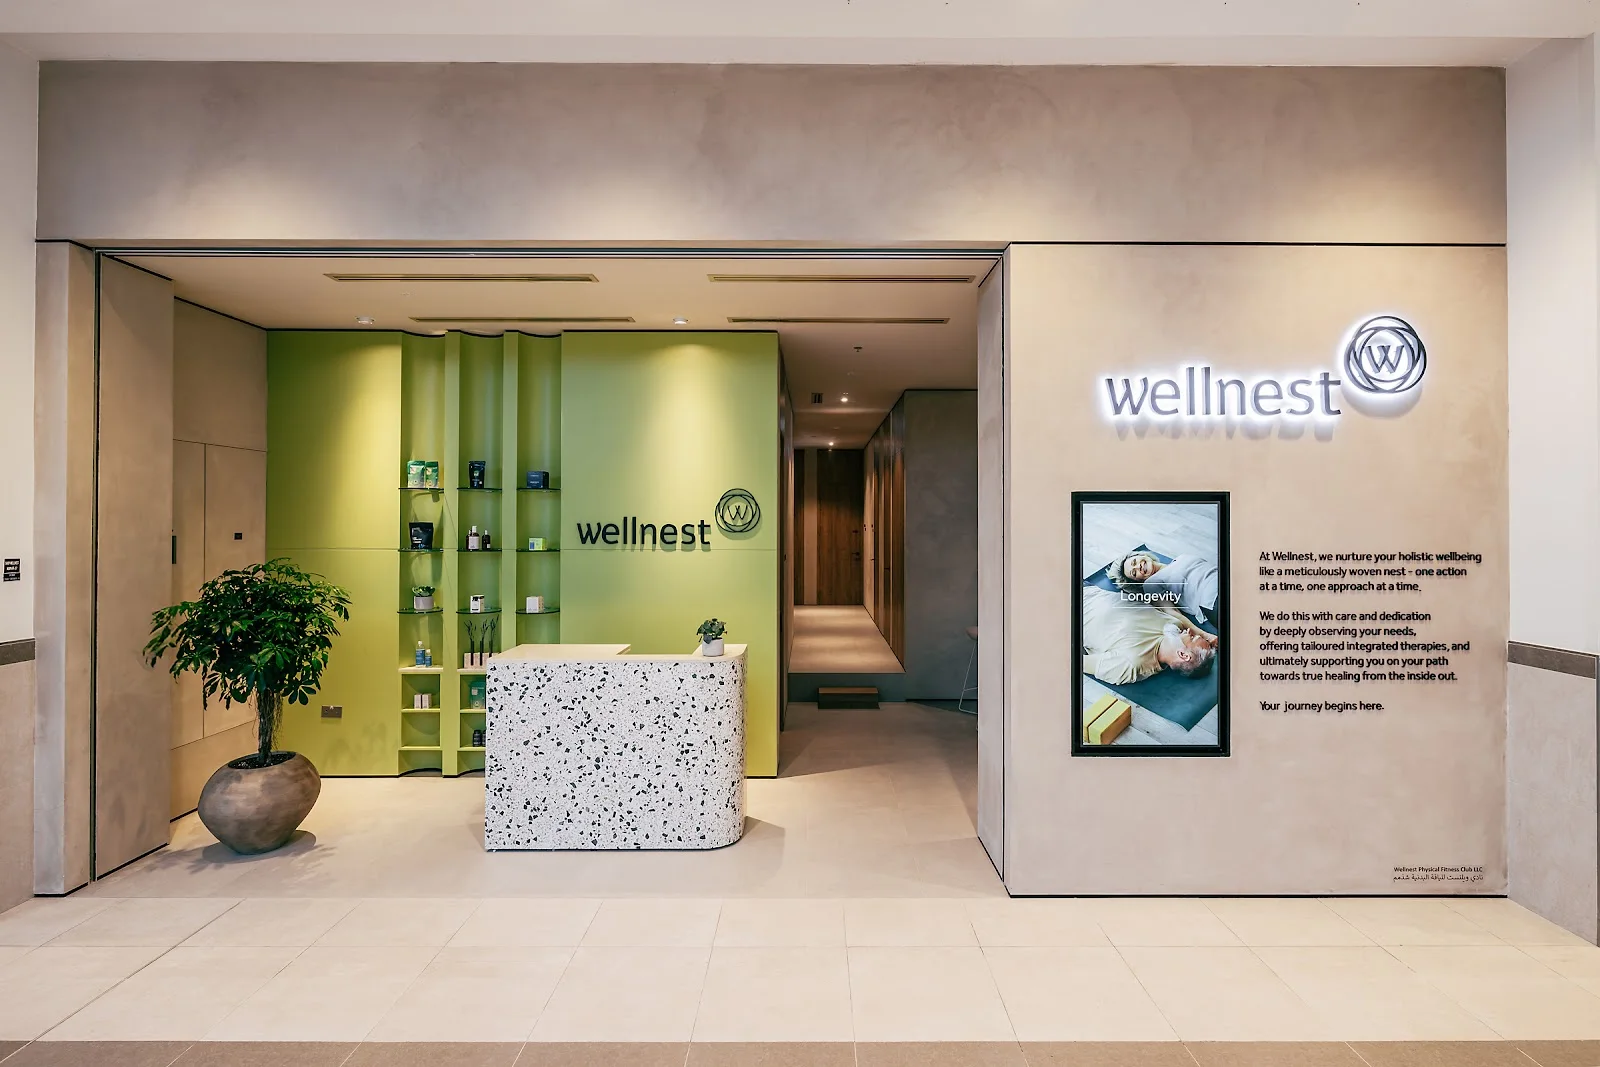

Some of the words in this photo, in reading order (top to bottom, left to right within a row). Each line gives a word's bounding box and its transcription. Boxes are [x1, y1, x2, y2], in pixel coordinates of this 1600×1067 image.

[1104, 366, 1342, 416] wellnest
[577, 516, 711, 545] wellnest
[1259, 552, 1270, 561] At
[1272, 551, 1317, 562] Wellnest,
[1336, 553, 1372, 561] nurture
[1374, 554, 1395, 563] your
[1398, 551, 1434, 561] holistic
[1435, 551, 1482, 563] wellbeing
[1259, 566, 1274, 576] like
[1285, 566, 1347, 578] meticulously
[1384, 567, 1406, 576] nest
[1436, 567, 1467, 576] action
[1259, 582, 1270, 591] at
[1279, 582, 1304, 592] time,
[1328, 581, 1374, 593] approach
[1376, 582, 1386, 591] at
[1396, 582, 1421, 591] time.
[1120, 590, 1181, 604] Longevity
[1260, 612, 1274, 620] We
[1277, 611, 1290, 620] do
[1292, 611, 1310, 620] this
[1312, 611, 1333, 620] with
[1359, 611, 1377, 620] and
[1379, 611, 1431, 620] dedication
[1260, 626, 1271, 638] by
[1274, 626, 1306, 638] deeply
[1309, 626, 1357, 638] observing
[1359, 628, 1381, 638] your
[1383, 626, 1416, 636] needs,
[1260, 641, 1298, 652] offering
[1301, 641, 1344, 650] tailoured
[1347, 641, 1398, 652] integrated
[1400, 641, 1449, 652] therapies,
[1452, 641, 1470, 650] and
[1260, 656, 1308, 667] ultimately
[1310, 656, 1364, 667] supporting
[1366, 658, 1385, 667] you
[1402, 658, 1424, 667] your
[1426, 656, 1448, 667] path
[1260, 671, 1300, 680] towards
[1302, 672, 1323, 680] true
[1325, 671, 1360, 682] healing
[1362, 671, 1386, 680] from
[1388, 671, 1405, 680] the
[1407, 671, 1436, 680] inside
[1438, 672, 1458, 680] out.
[1260, 701, 1279, 710] Your
[1284, 701, 1322, 712] journey
[1324, 701, 1357, 712] begins
[1359, 701, 1384, 710] here.
